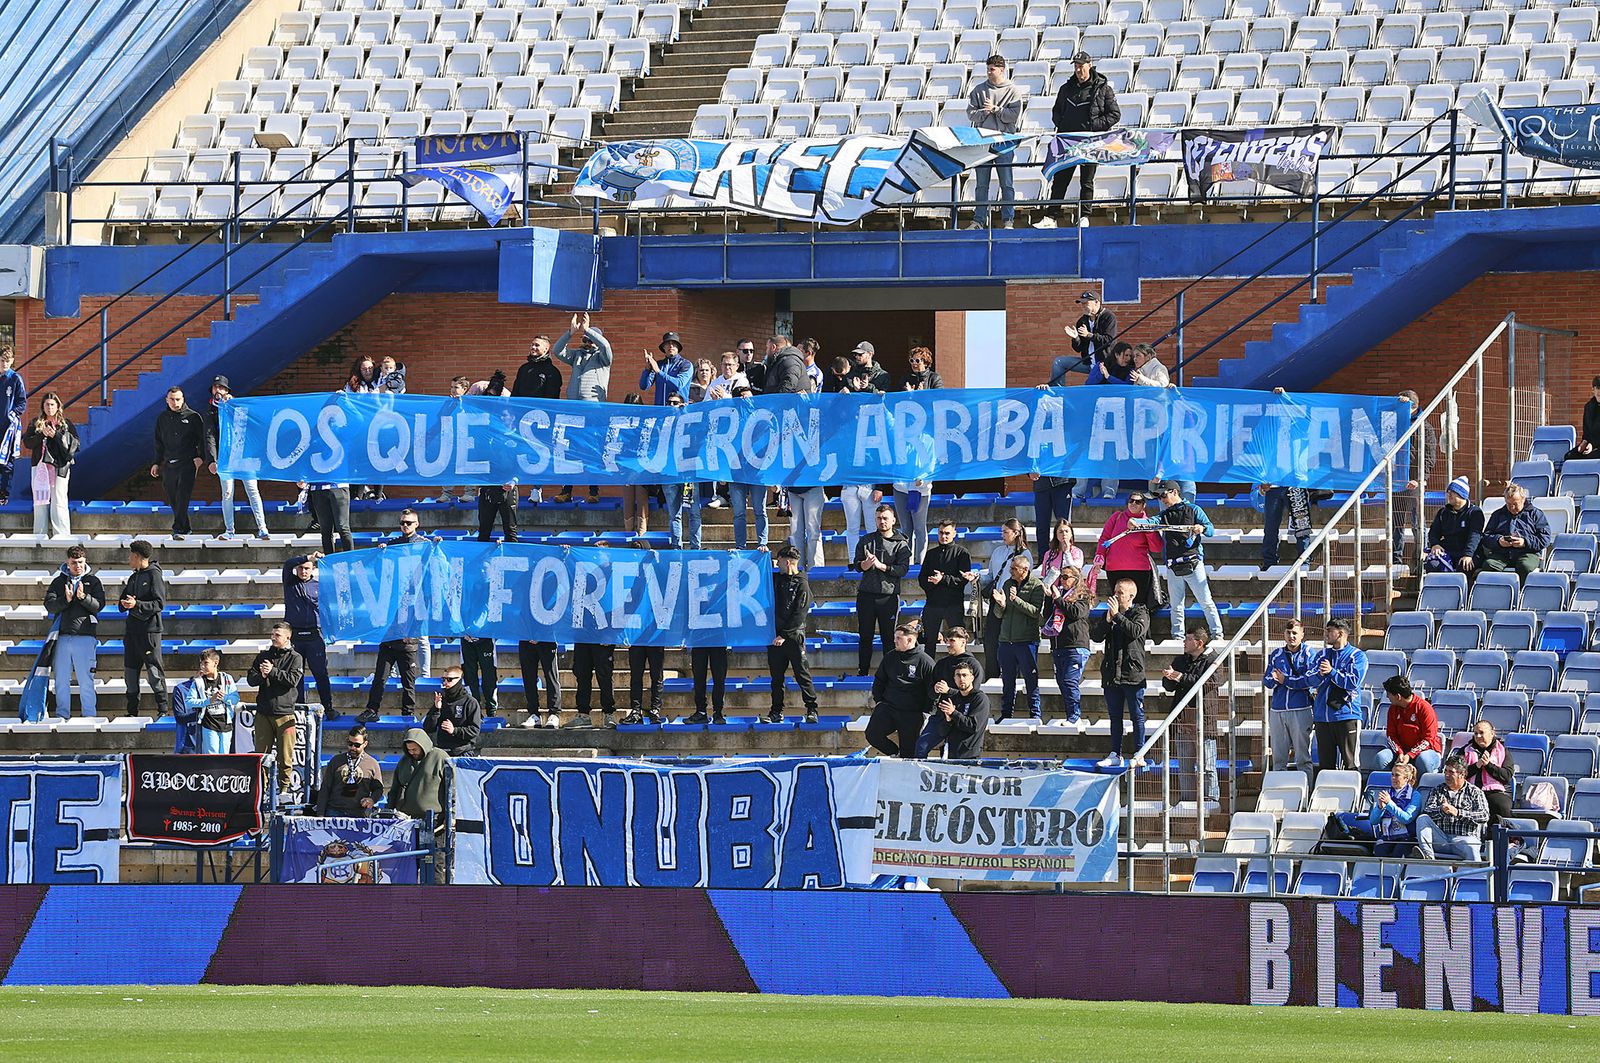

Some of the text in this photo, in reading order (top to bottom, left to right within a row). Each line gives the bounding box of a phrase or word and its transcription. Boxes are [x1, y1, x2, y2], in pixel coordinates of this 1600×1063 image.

[228, 395, 1397, 483] LOS QUE SE FUERON, ARRIBA APRIETAN
[332, 554, 768, 630] IVAN FOREVER
[919, 769, 1023, 797] SECTOR
[478, 763, 846, 890] ONUBA
[876, 851, 927, 866] DECANO
[932, 856, 954, 868] DEL
[1250, 901, 1600, 1016] BIENVE
